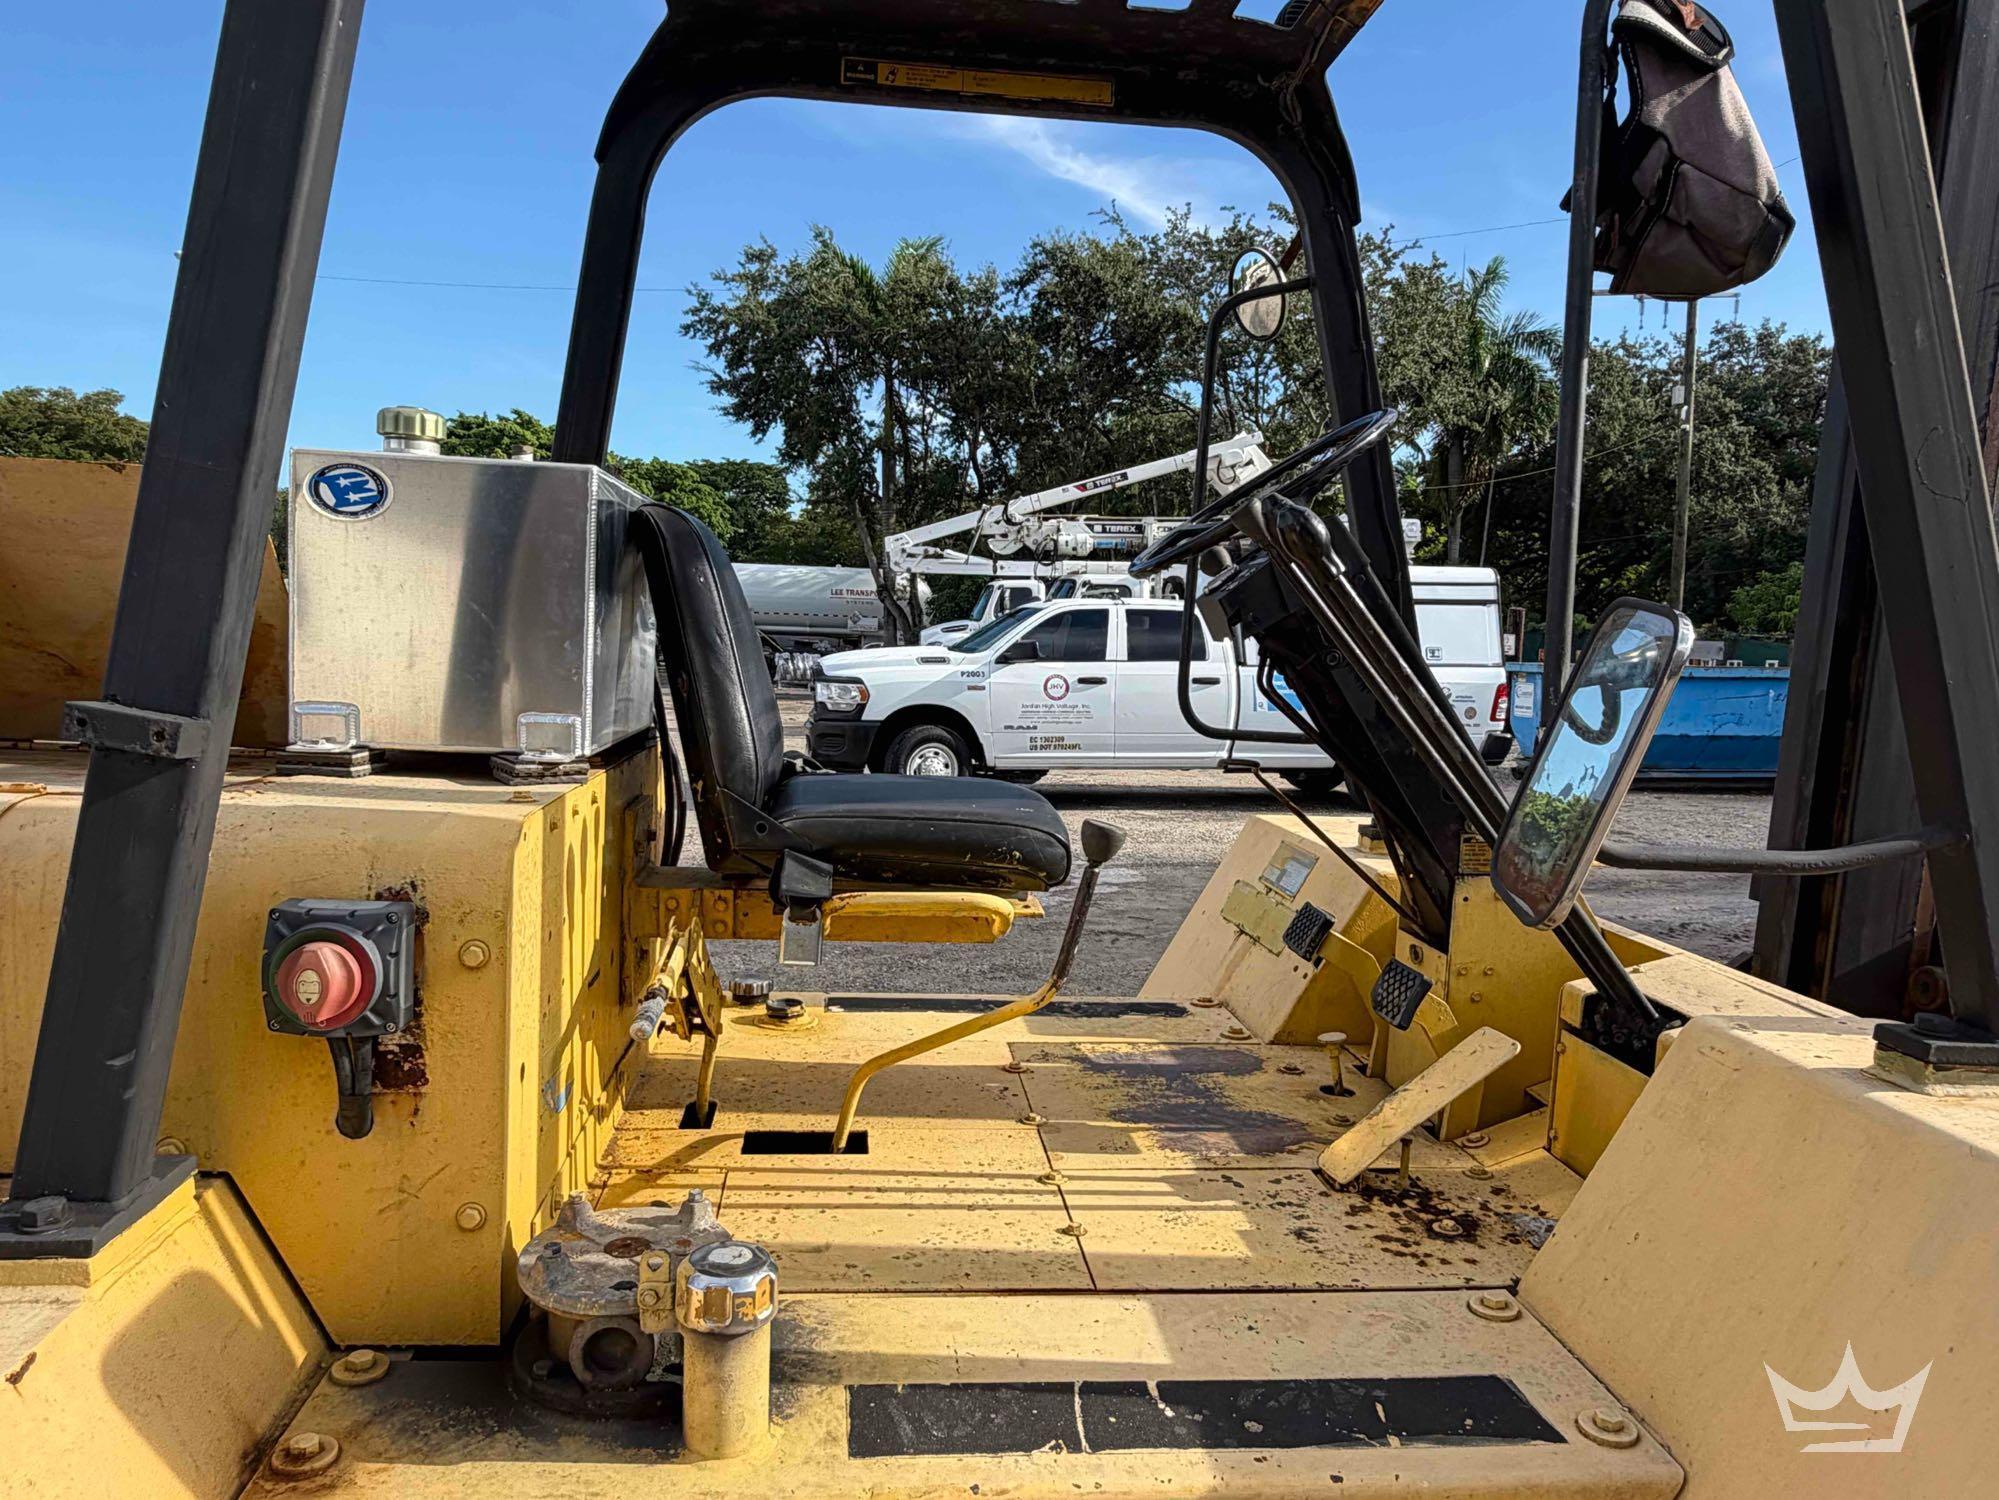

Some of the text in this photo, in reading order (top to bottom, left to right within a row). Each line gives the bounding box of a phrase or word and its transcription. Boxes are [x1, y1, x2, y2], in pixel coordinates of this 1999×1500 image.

[1096, 475, 1122, 487] TEREX
[1104, 525, 1136, 533] TEREX
[830, 588, 880, 597] LEE TRANSPO
